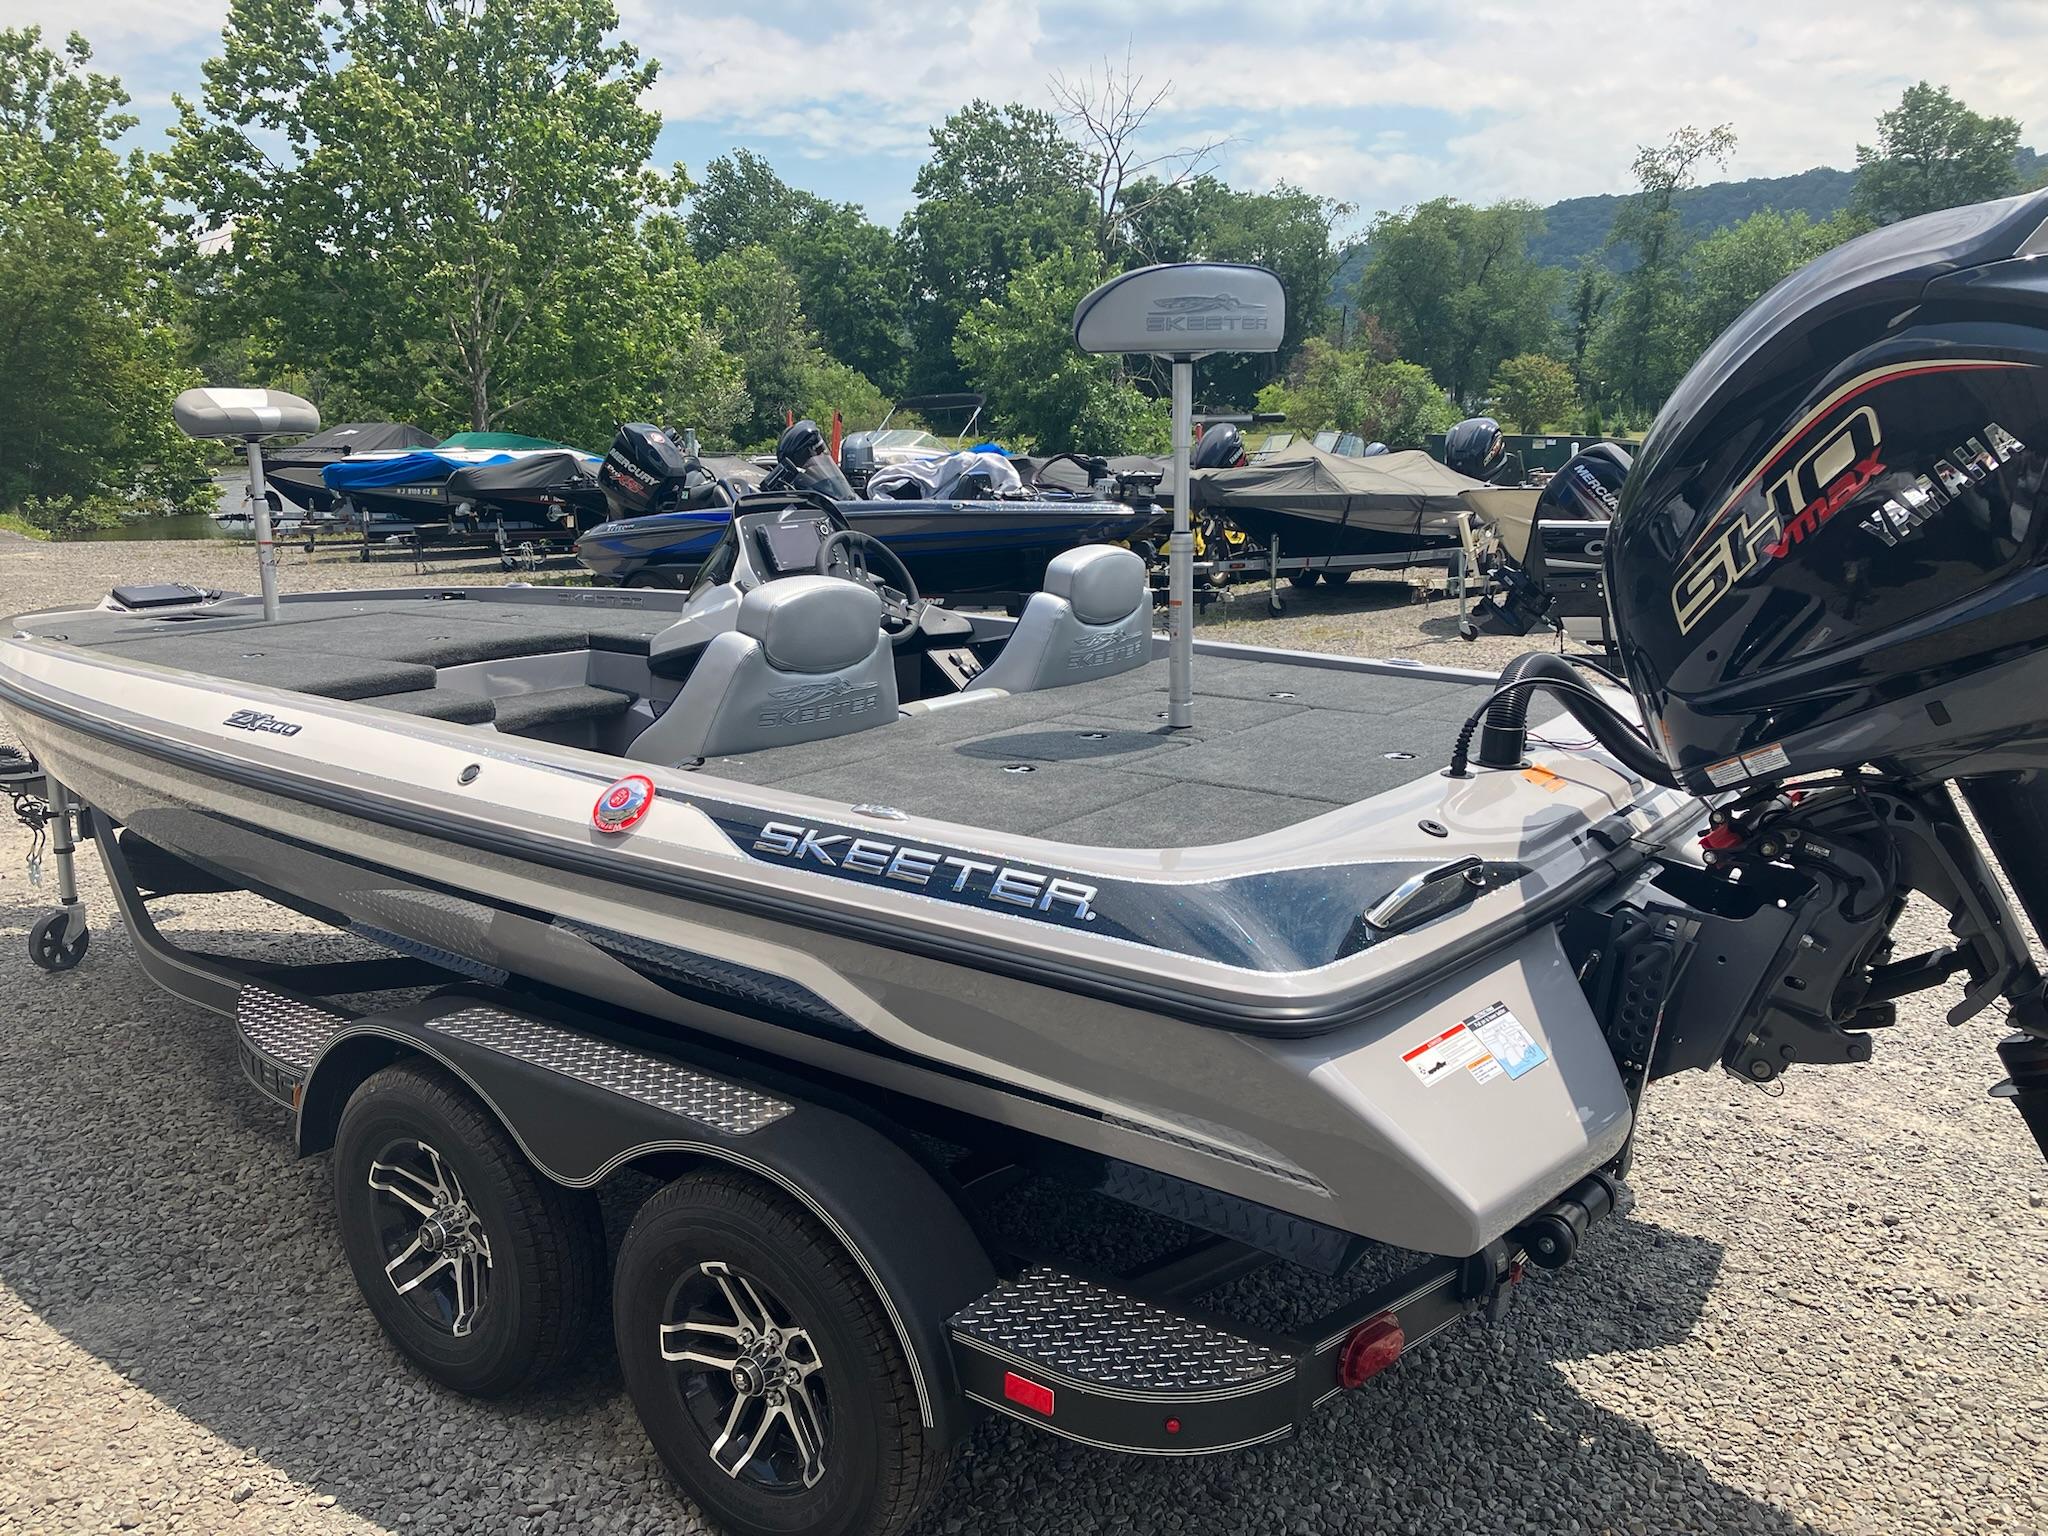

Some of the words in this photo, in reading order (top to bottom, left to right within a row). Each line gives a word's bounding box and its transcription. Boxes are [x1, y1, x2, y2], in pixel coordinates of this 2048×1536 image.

[1146, 315, 1268, 332] SKEETER
[609, 447, 661, 487] MERCURY
[1574, 464, 1618, 510] MERCUR
[1858, 422, 2026, 548] YAMAHA
[558, 592, 644, 606] SKEETER
[1067, 640, 1142, 670] SKEETER
[222, 709, 303, 737] ZX200
[758, 693, 878, 728] SKEETER
[752, 821, 1098, 921] SKEETER
